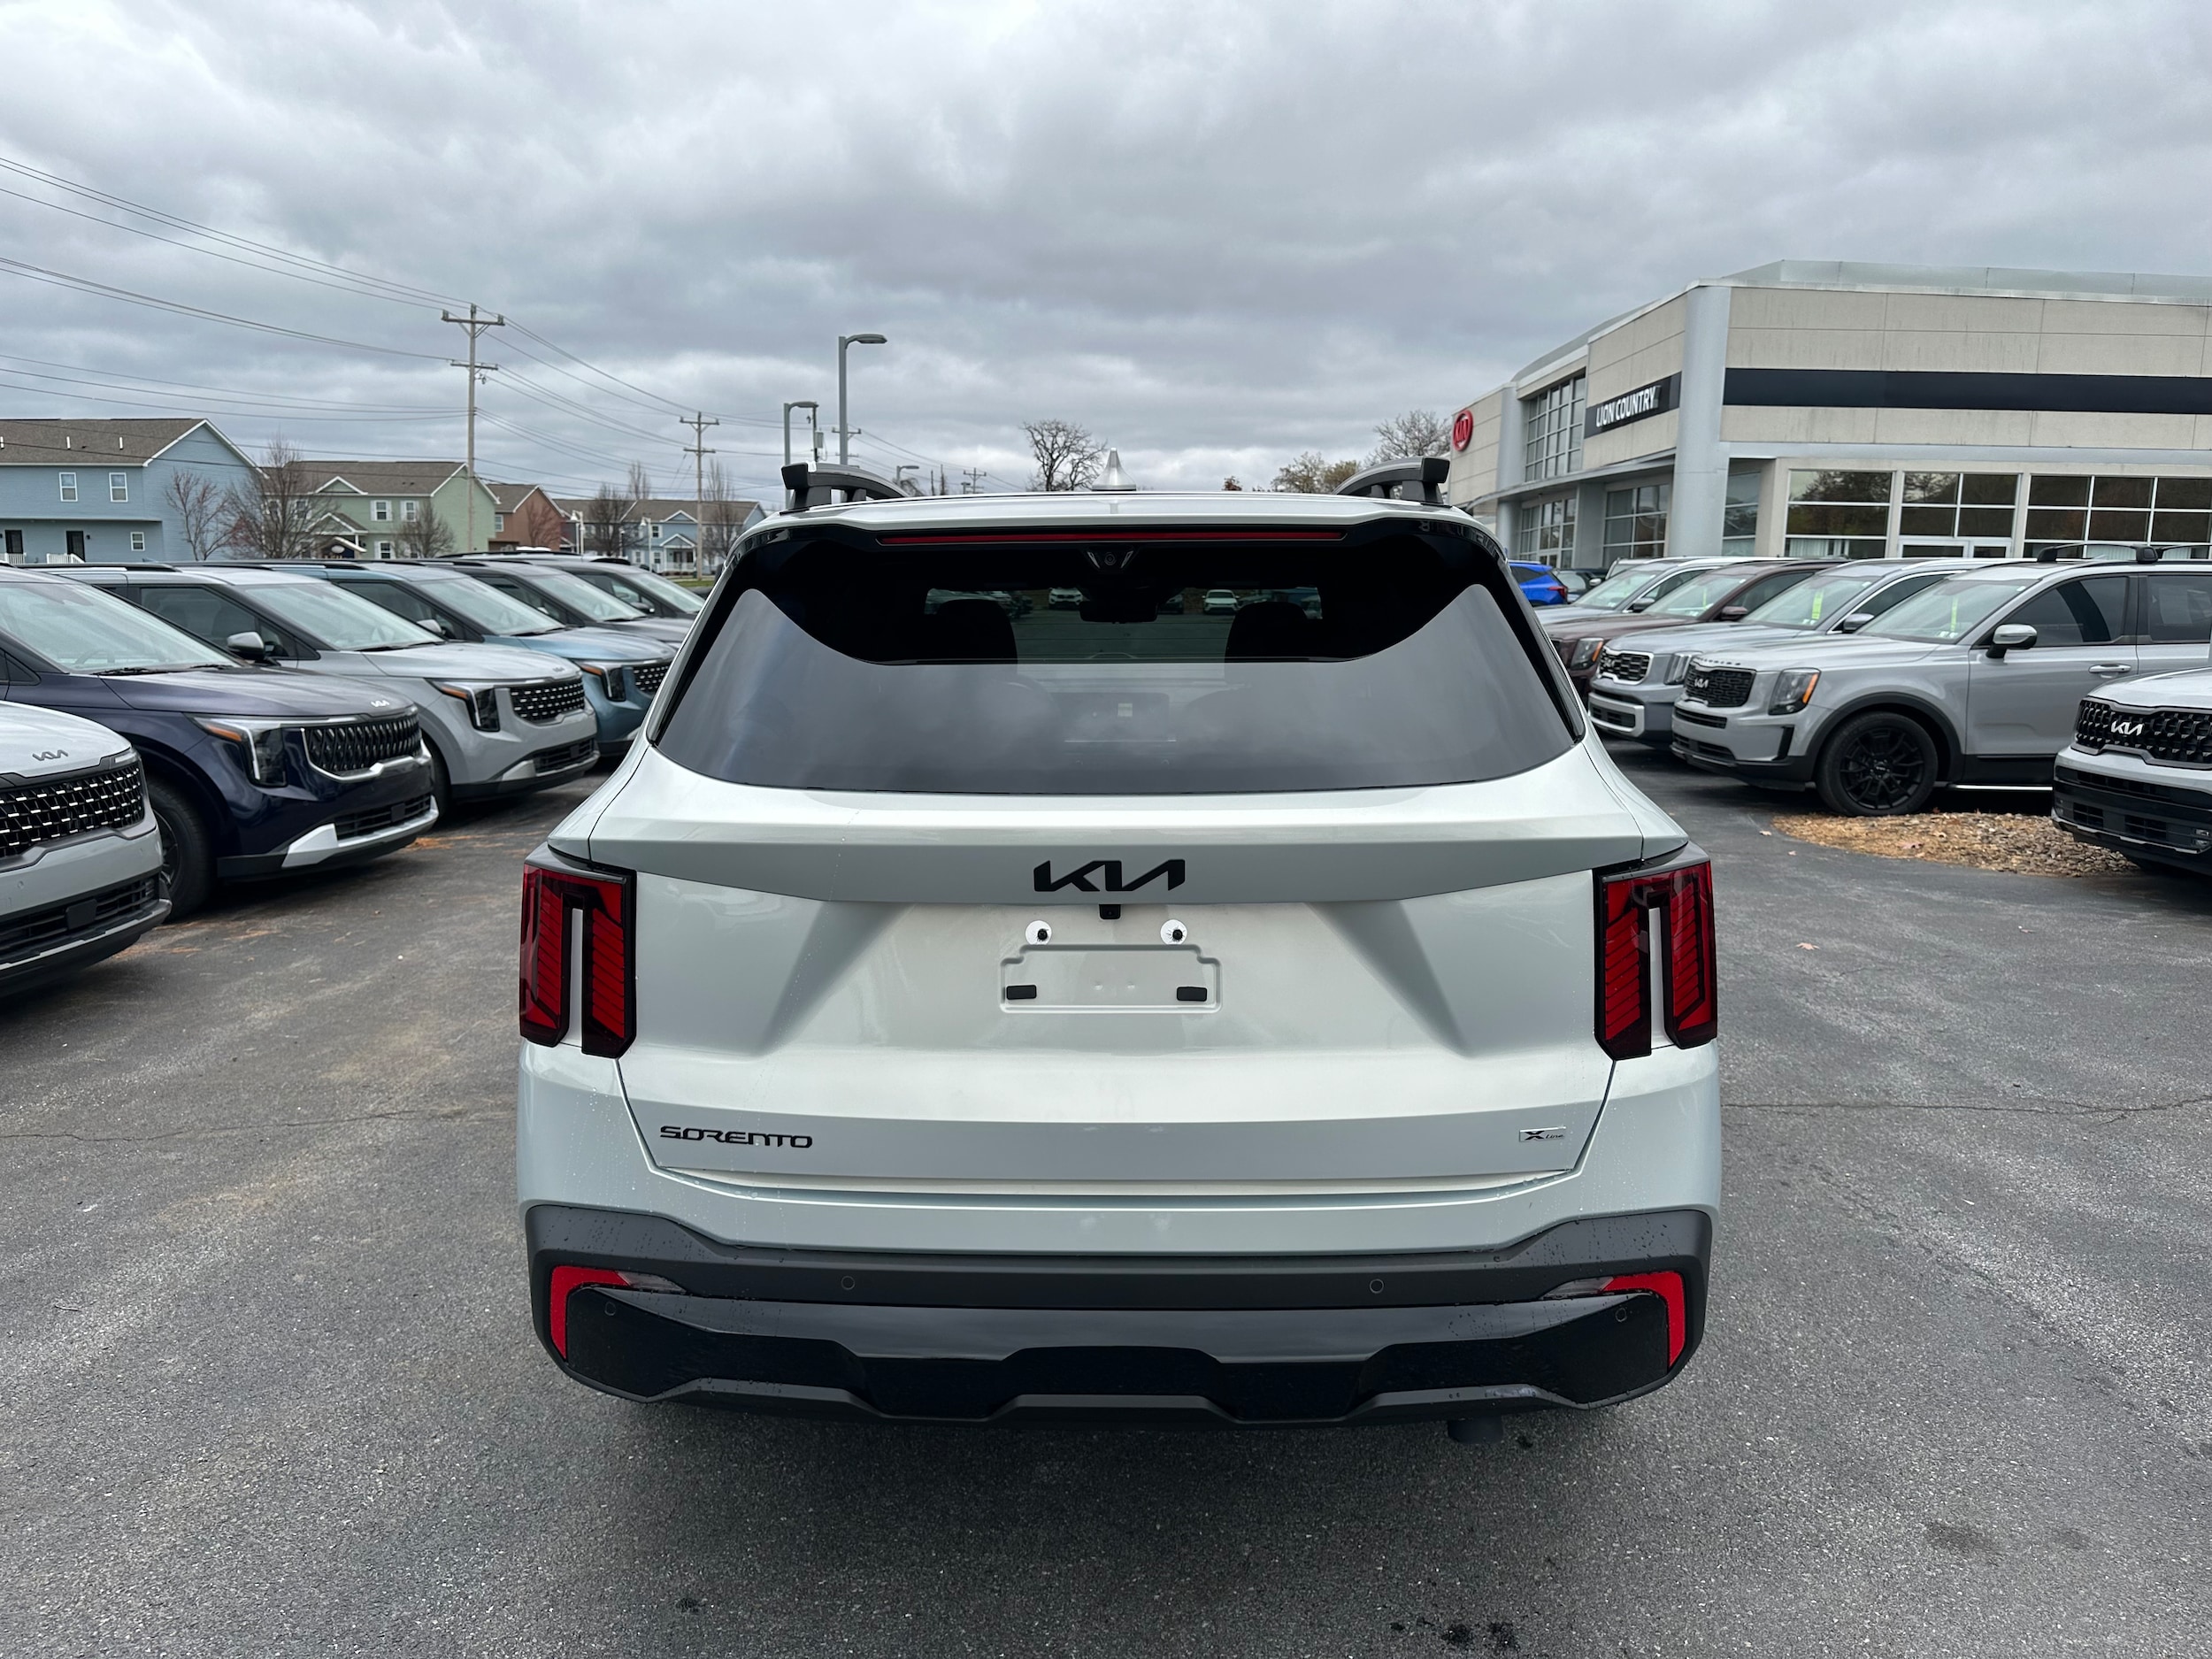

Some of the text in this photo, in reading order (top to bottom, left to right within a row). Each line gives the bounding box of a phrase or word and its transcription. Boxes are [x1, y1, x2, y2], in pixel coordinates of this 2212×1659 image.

[1595, 386, 1657, 427] LION COUNTRY
[2110, 720, 2145, 736] KIA
[1033, 859, 1186, 892] KIA
[660, 1125, 813, 1148] SORENTO
